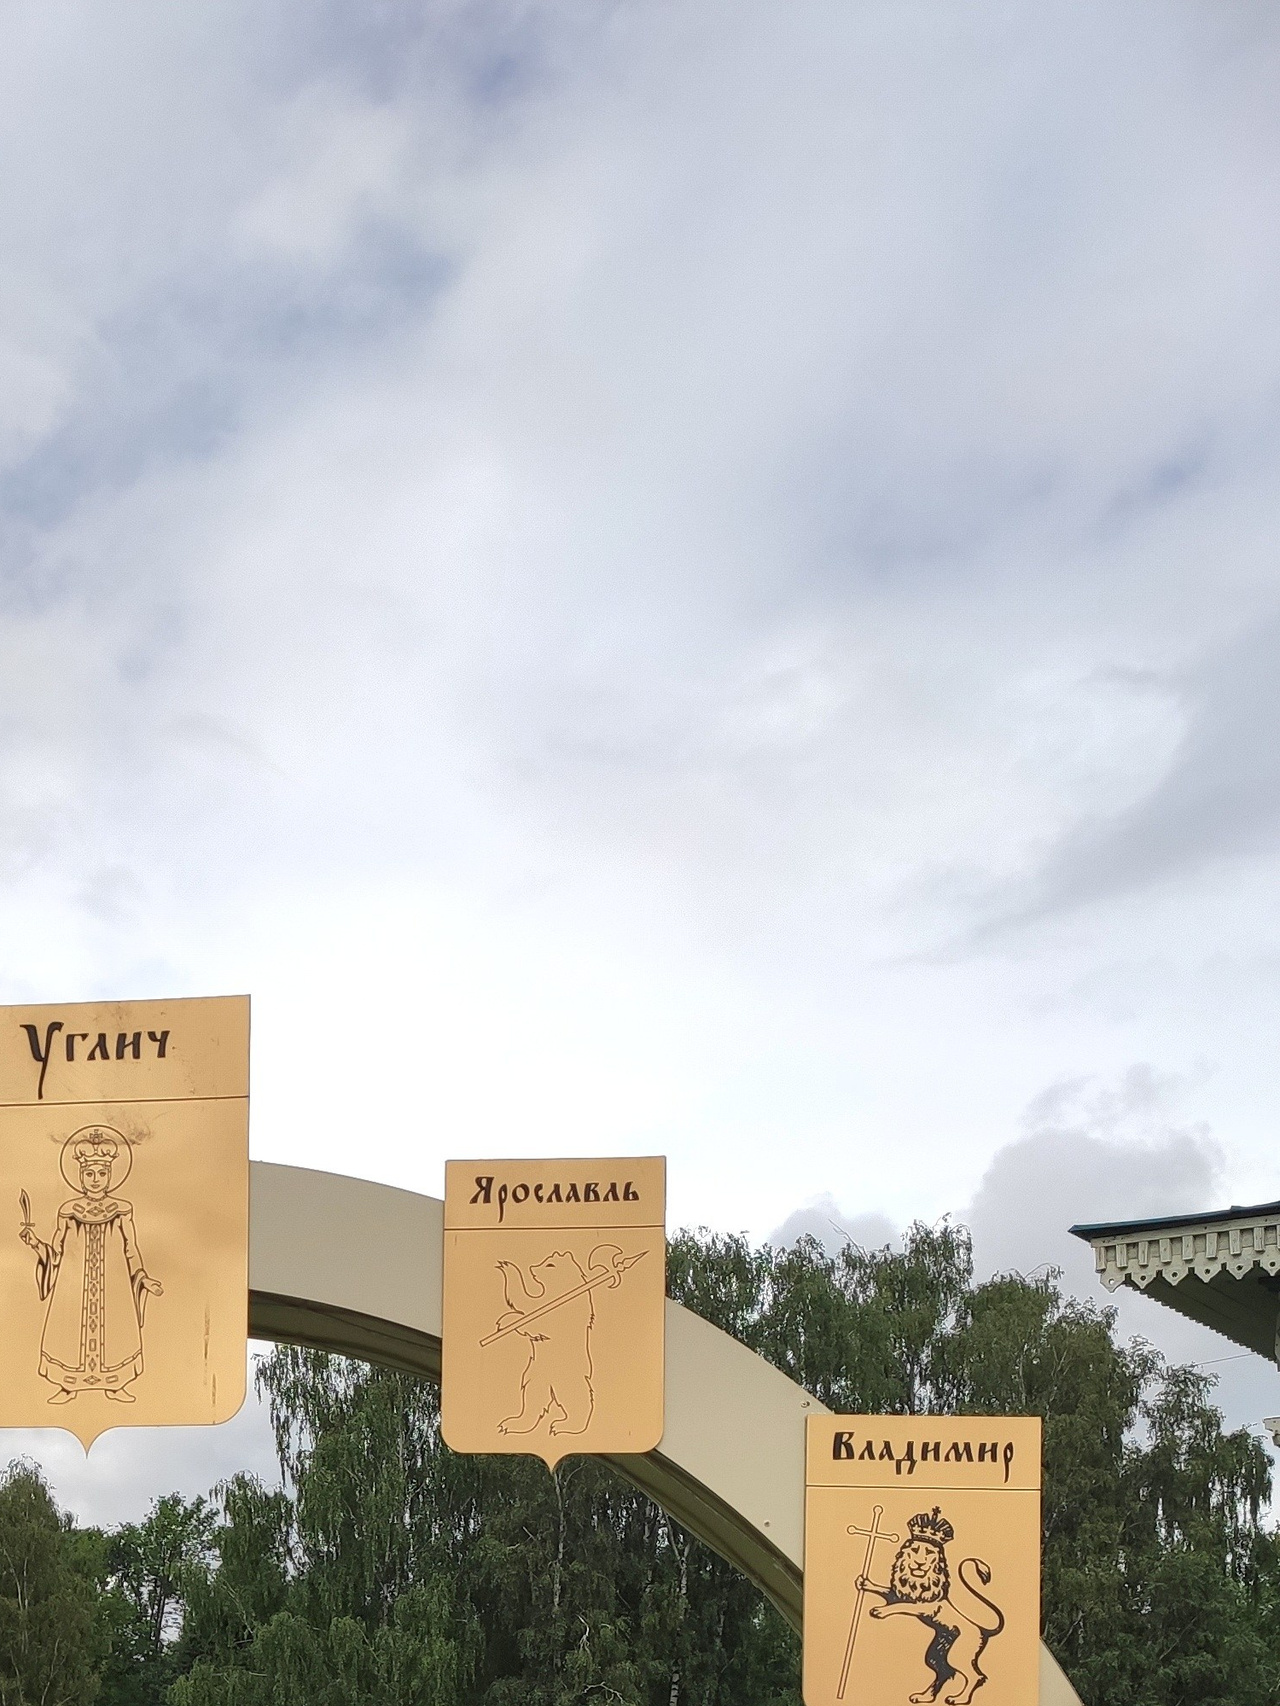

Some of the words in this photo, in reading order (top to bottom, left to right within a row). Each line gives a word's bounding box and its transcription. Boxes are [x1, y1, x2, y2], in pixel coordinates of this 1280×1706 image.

[20, 1021, 170, 1100] Углич
[469, 1176, 640, 1223] Ярославль
[832, 1431, 1014, 1483] Владимир
